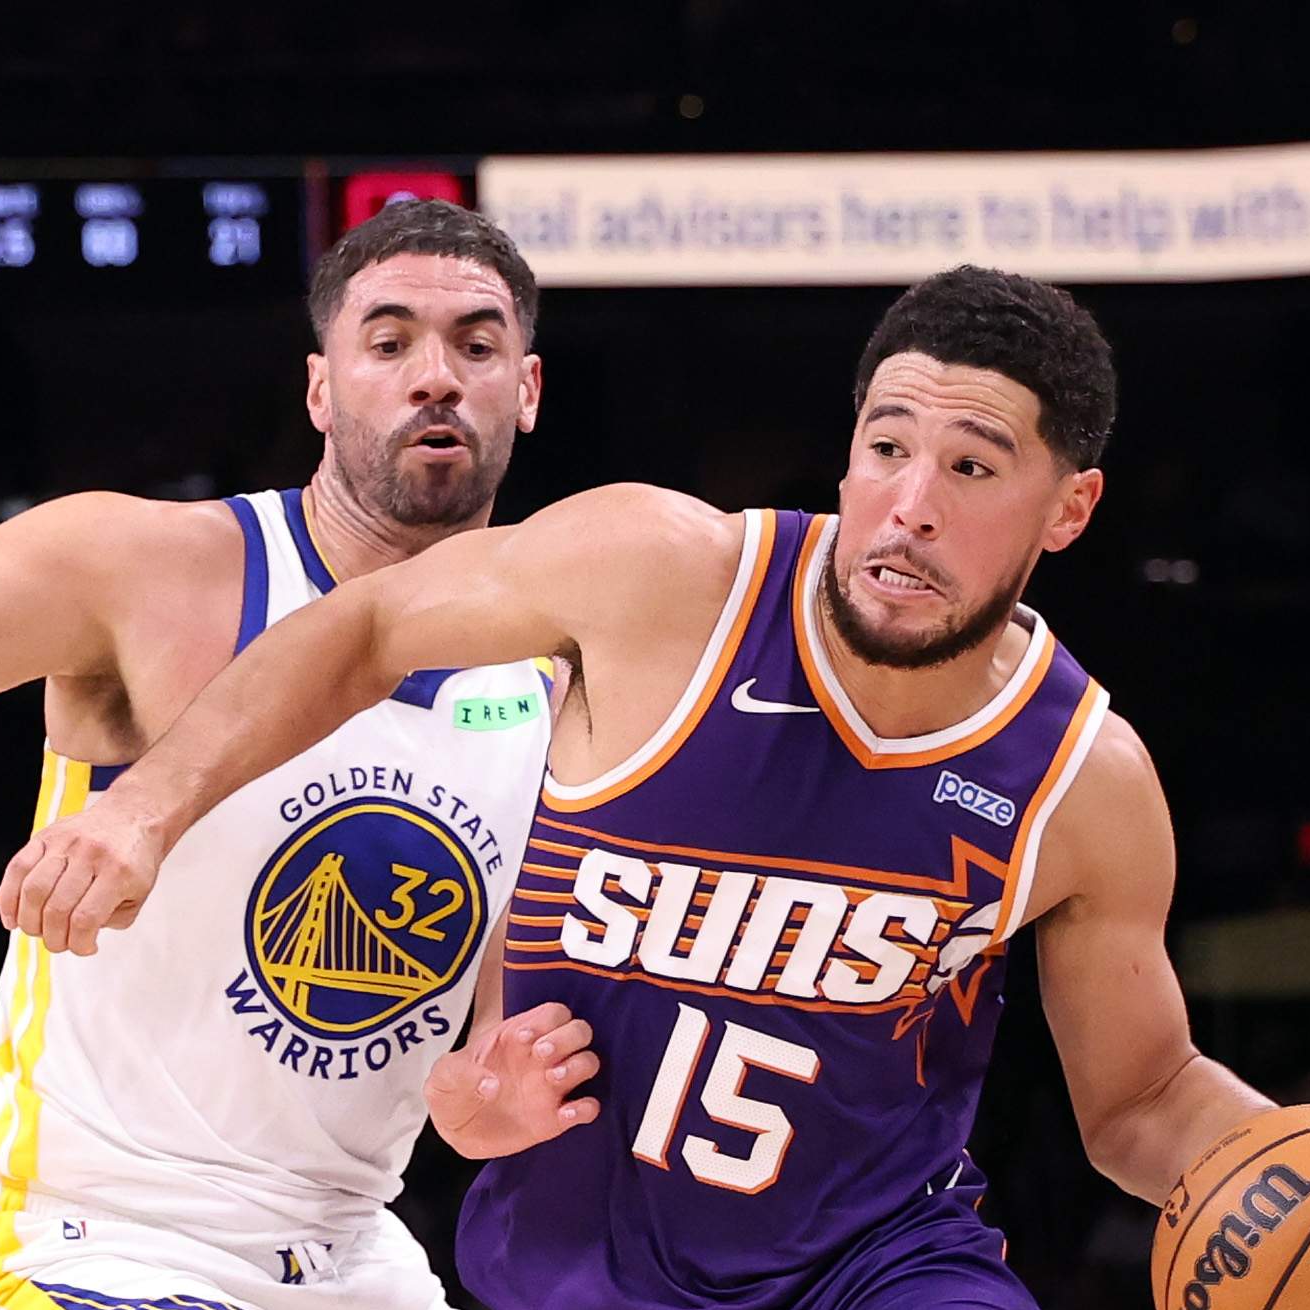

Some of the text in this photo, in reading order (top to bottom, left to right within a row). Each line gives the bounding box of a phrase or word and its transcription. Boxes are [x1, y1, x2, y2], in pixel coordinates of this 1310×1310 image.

[591, 192, 824, 249] advisors
[839, 188, 968, 249] here
[461, 700, 530, 724] IREN
[280, 766, 503, 875] GOLDEN STATE
[935, 773, 1014, 824] paze
[374, 864, 465, 943] 32
[224, 967, 451, 1080] WARRIORS
[631, 1001, 821, 1196] 15
